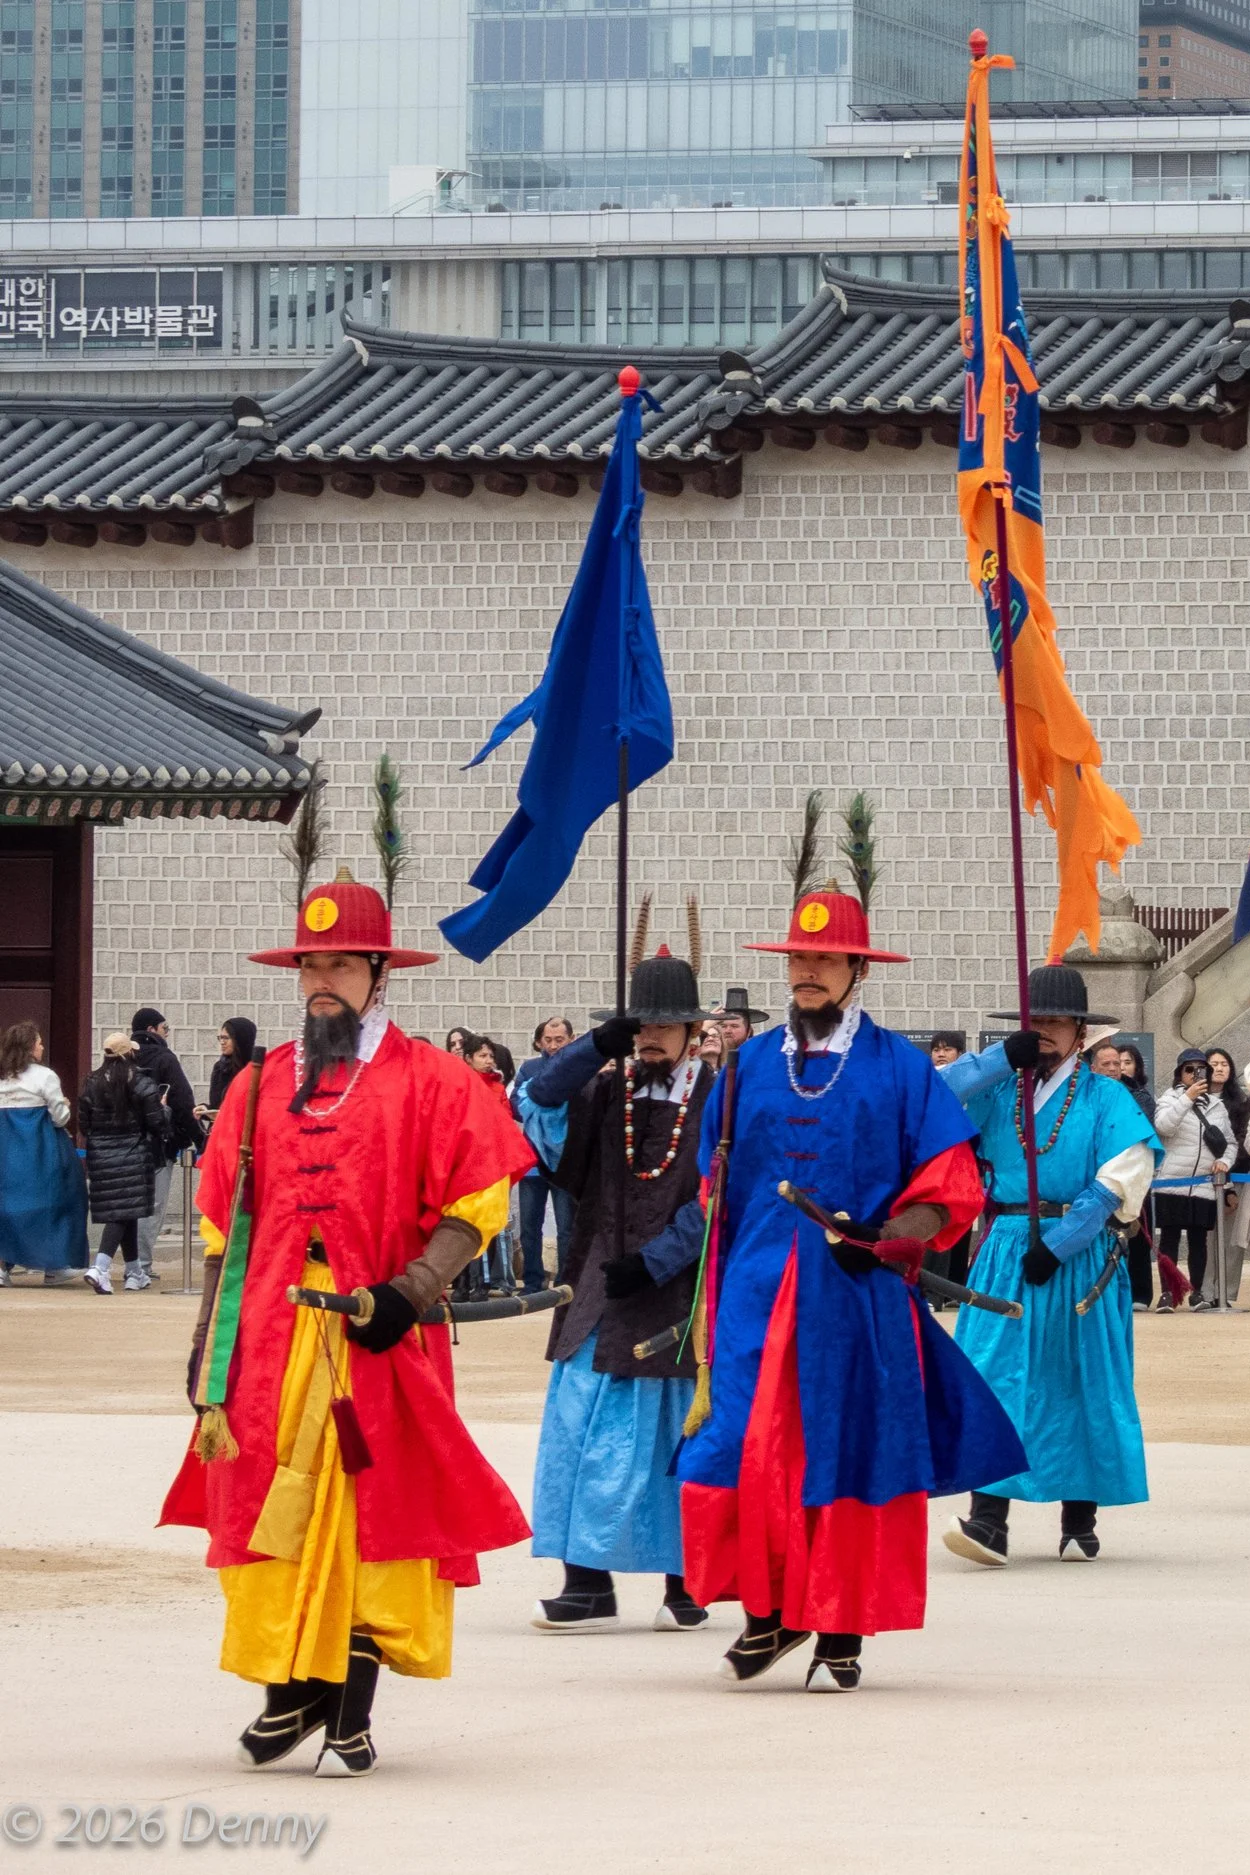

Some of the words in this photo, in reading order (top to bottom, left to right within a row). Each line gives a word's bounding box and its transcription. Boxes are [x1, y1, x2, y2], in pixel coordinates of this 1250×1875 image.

[0, 277, 46, 307] 대한
[0, 311, 44, 339] 민국
[60, 305, 217, 338] 역사박물관
